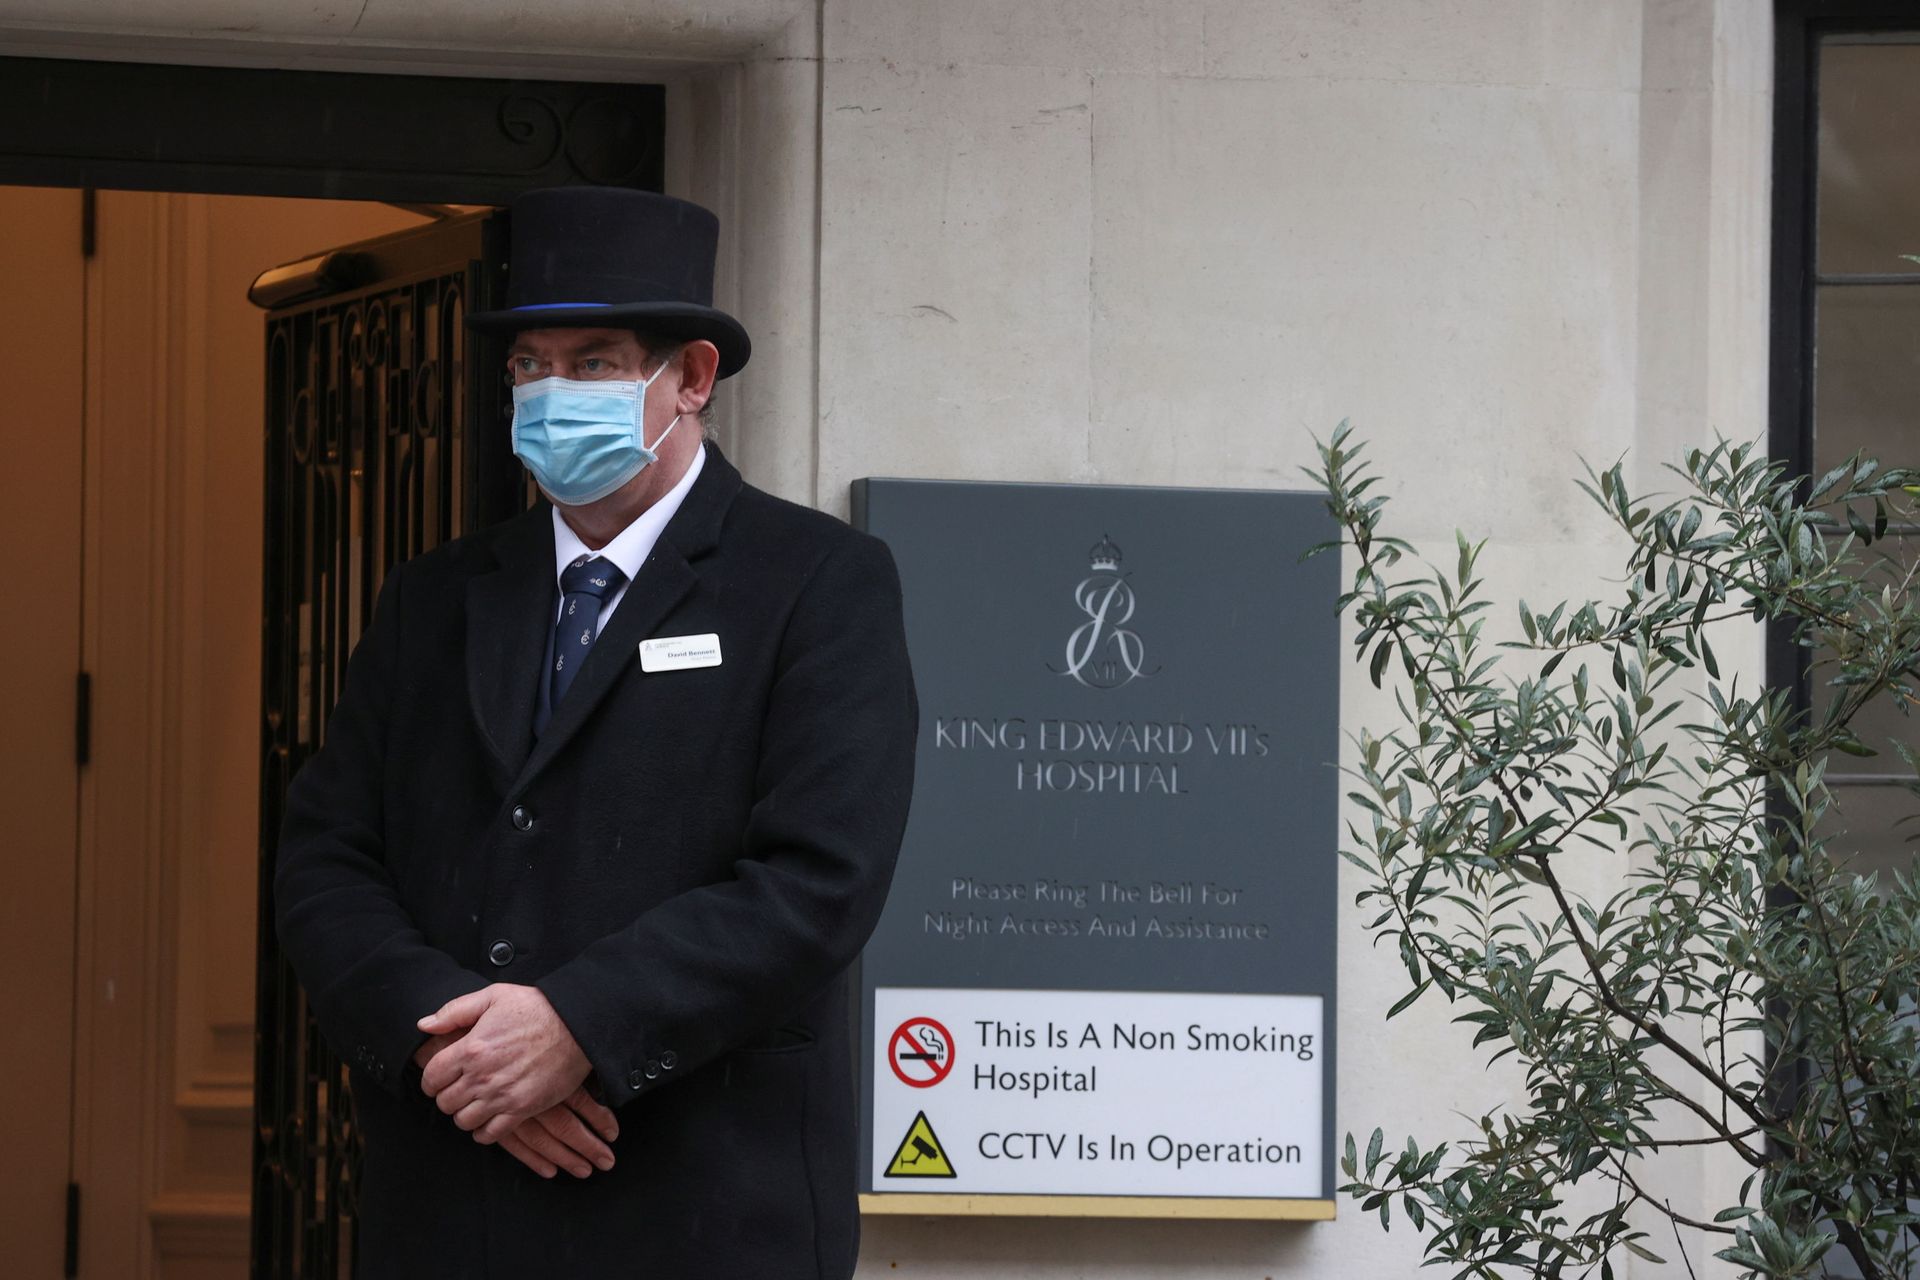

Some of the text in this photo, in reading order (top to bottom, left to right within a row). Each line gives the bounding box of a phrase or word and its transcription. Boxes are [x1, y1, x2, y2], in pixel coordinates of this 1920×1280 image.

[936, 716, 1026, 750] KING
[1040, 719, 1193, 754] EDWARD
[1017, 759, 1188, 794] HOSPITAL
[952, 878, 1243, 908] Please Ring The Bell For
[924, 912, 1269, 940] Night Access And Assistance
[975, 1021, 1314, 1061] This Is A Non Smoking
[974, 1064, 1096, 1099] Hospital
[978, 1133, 1301, 1170] CCTV Is In Operation
